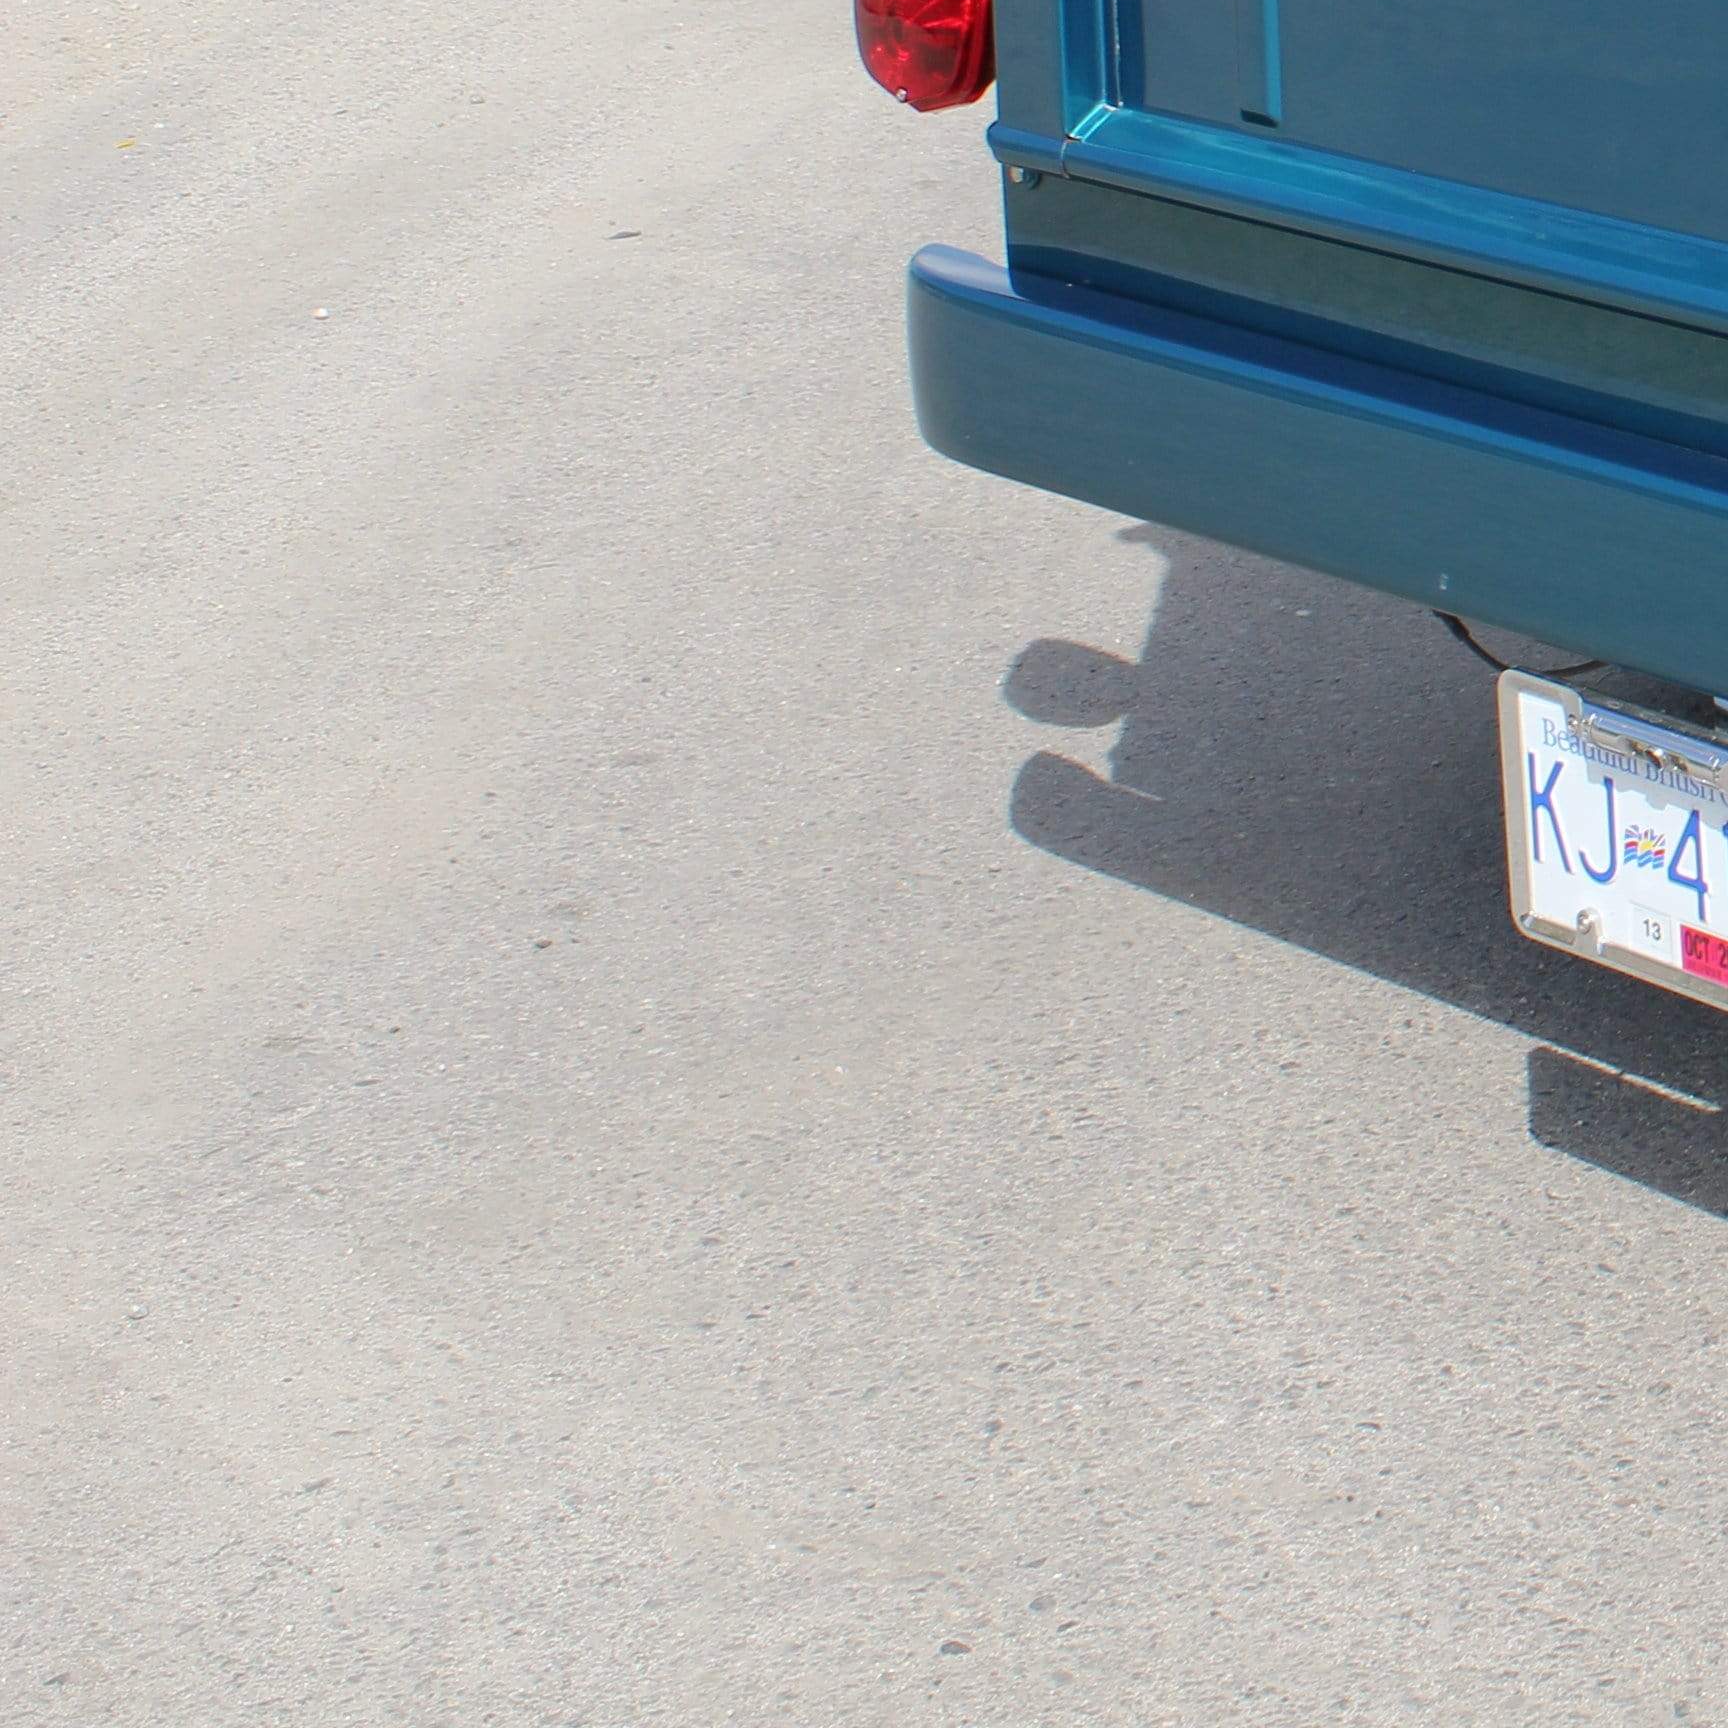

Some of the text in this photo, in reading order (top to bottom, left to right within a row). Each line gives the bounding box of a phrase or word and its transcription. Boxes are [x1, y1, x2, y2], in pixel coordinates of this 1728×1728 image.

[1528, 752, 1618, 884] KJ
[1643, 918, 1662, 941] 13
[1685, 931, 1710, 964] OCT
